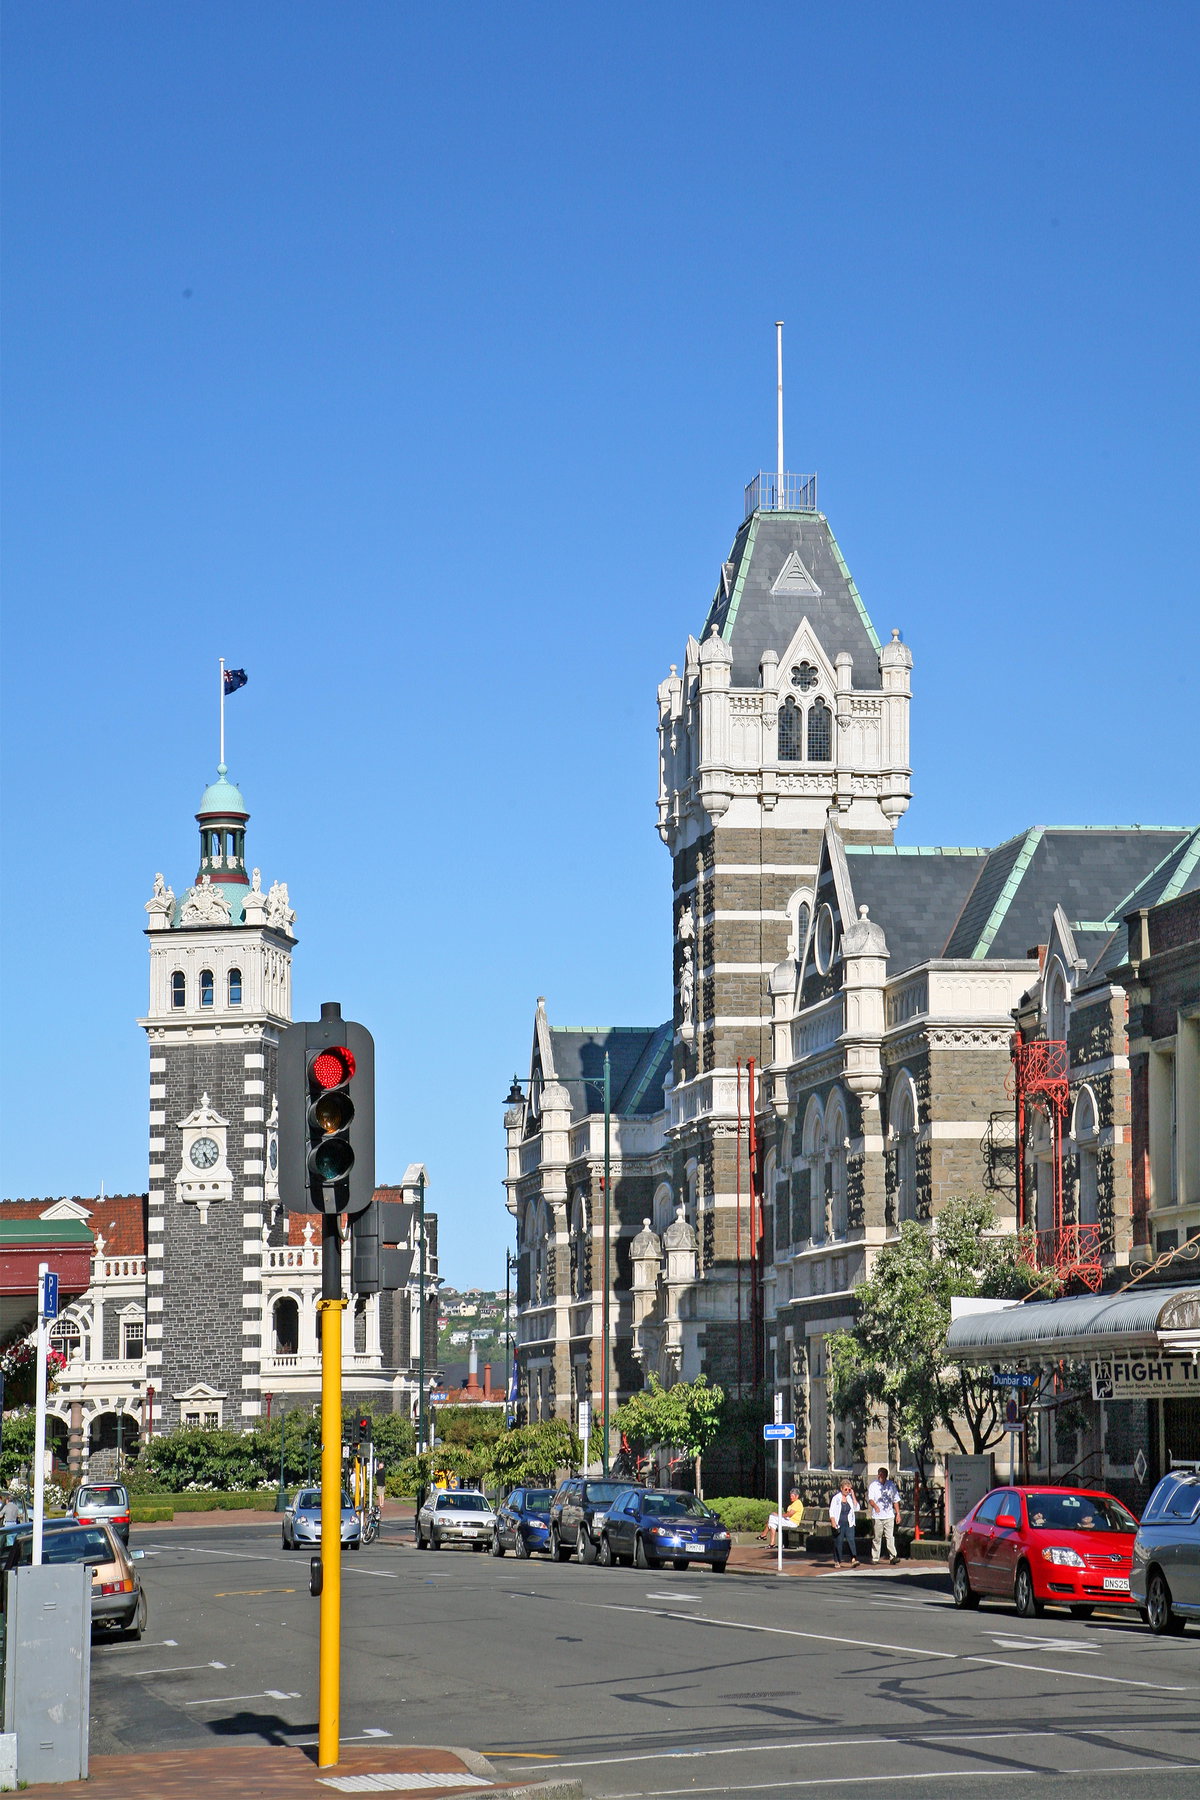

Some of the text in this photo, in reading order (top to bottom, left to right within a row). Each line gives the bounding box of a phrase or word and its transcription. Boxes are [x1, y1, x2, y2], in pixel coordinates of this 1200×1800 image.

[48, 1276, 54, 1293] P
[49, 1295, 53, 1308] 5
[1113, 1362, 1174, 1382] FIGHT
[993, 1375, 1032, 1386] Dunbar St
[430, 1392, 440, 1401] High
